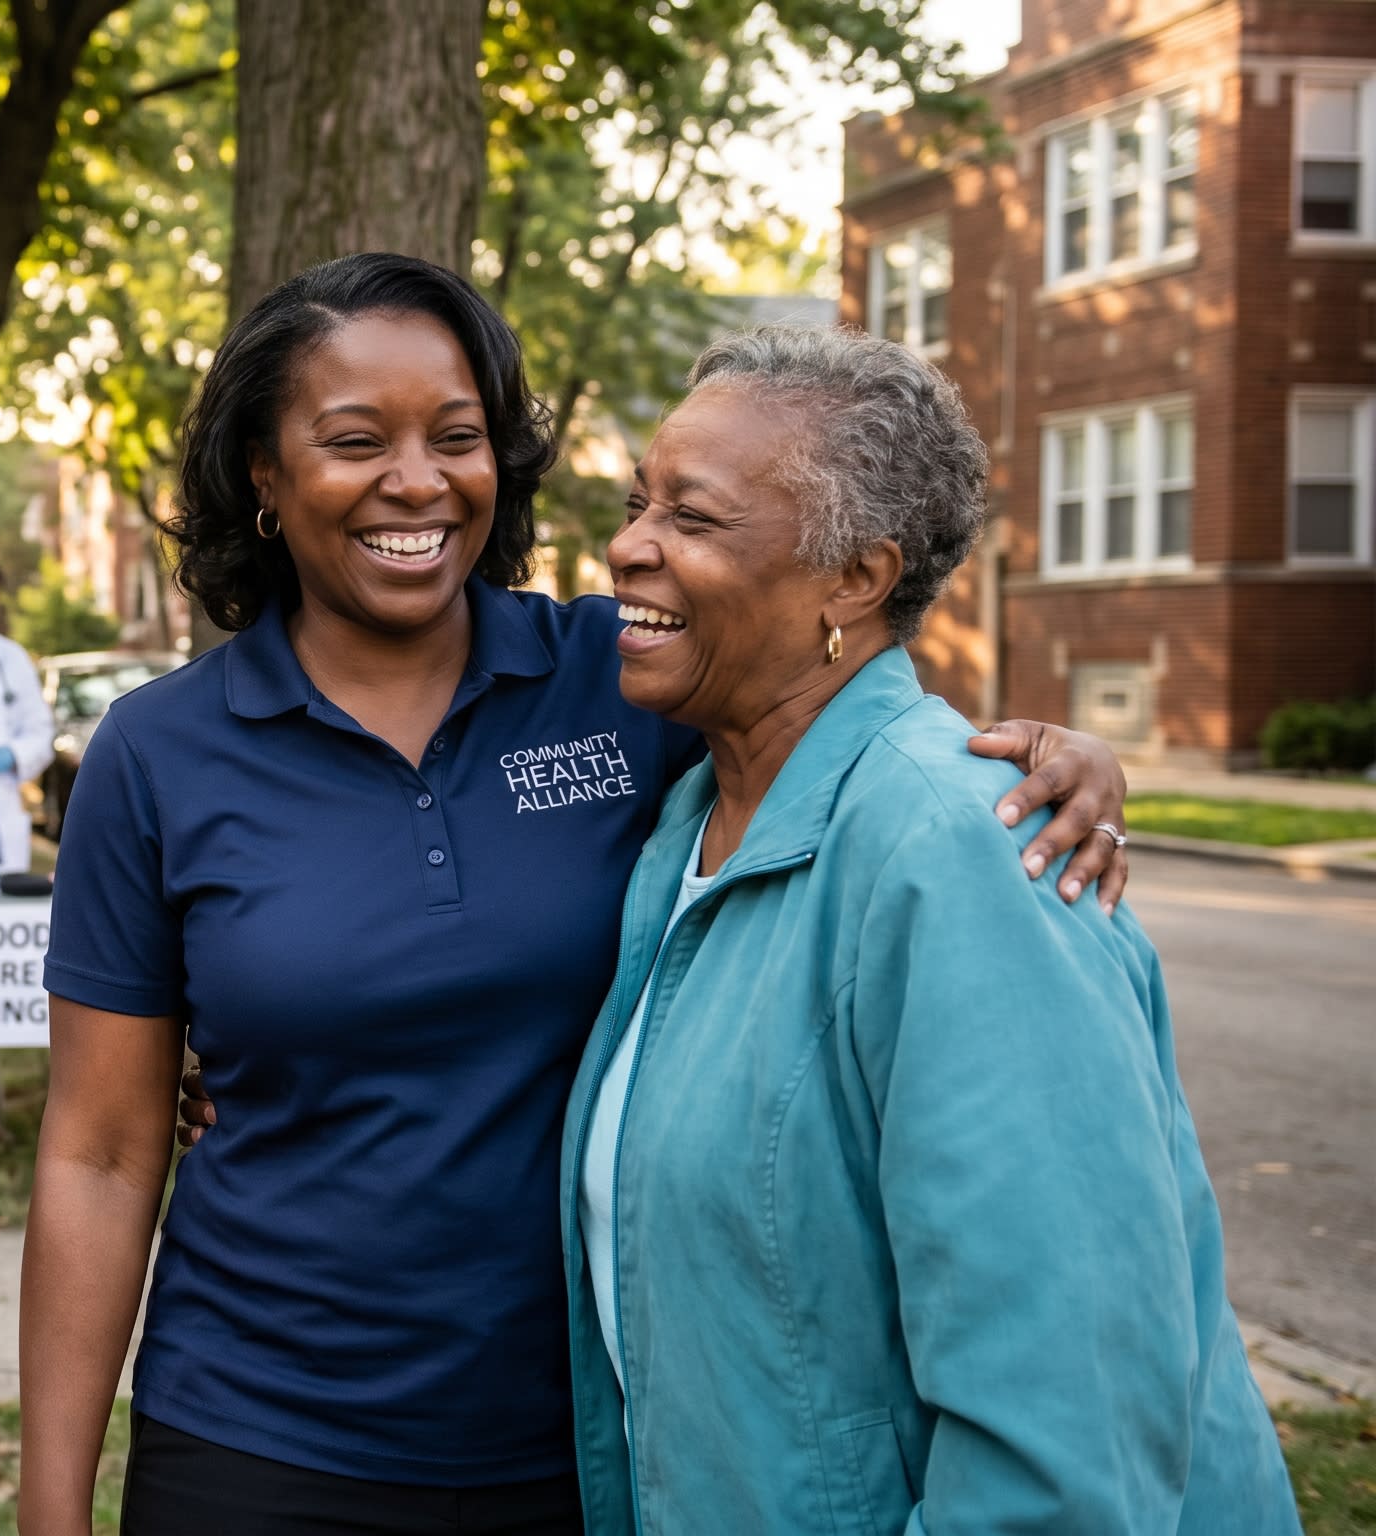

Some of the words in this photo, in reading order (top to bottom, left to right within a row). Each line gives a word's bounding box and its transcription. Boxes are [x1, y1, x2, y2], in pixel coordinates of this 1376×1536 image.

[499, 731, 617, 769] COMMUNITY
[505, 750, 629, 792] HEALTH
[516, 774, 636, 814] ALLIANCE
